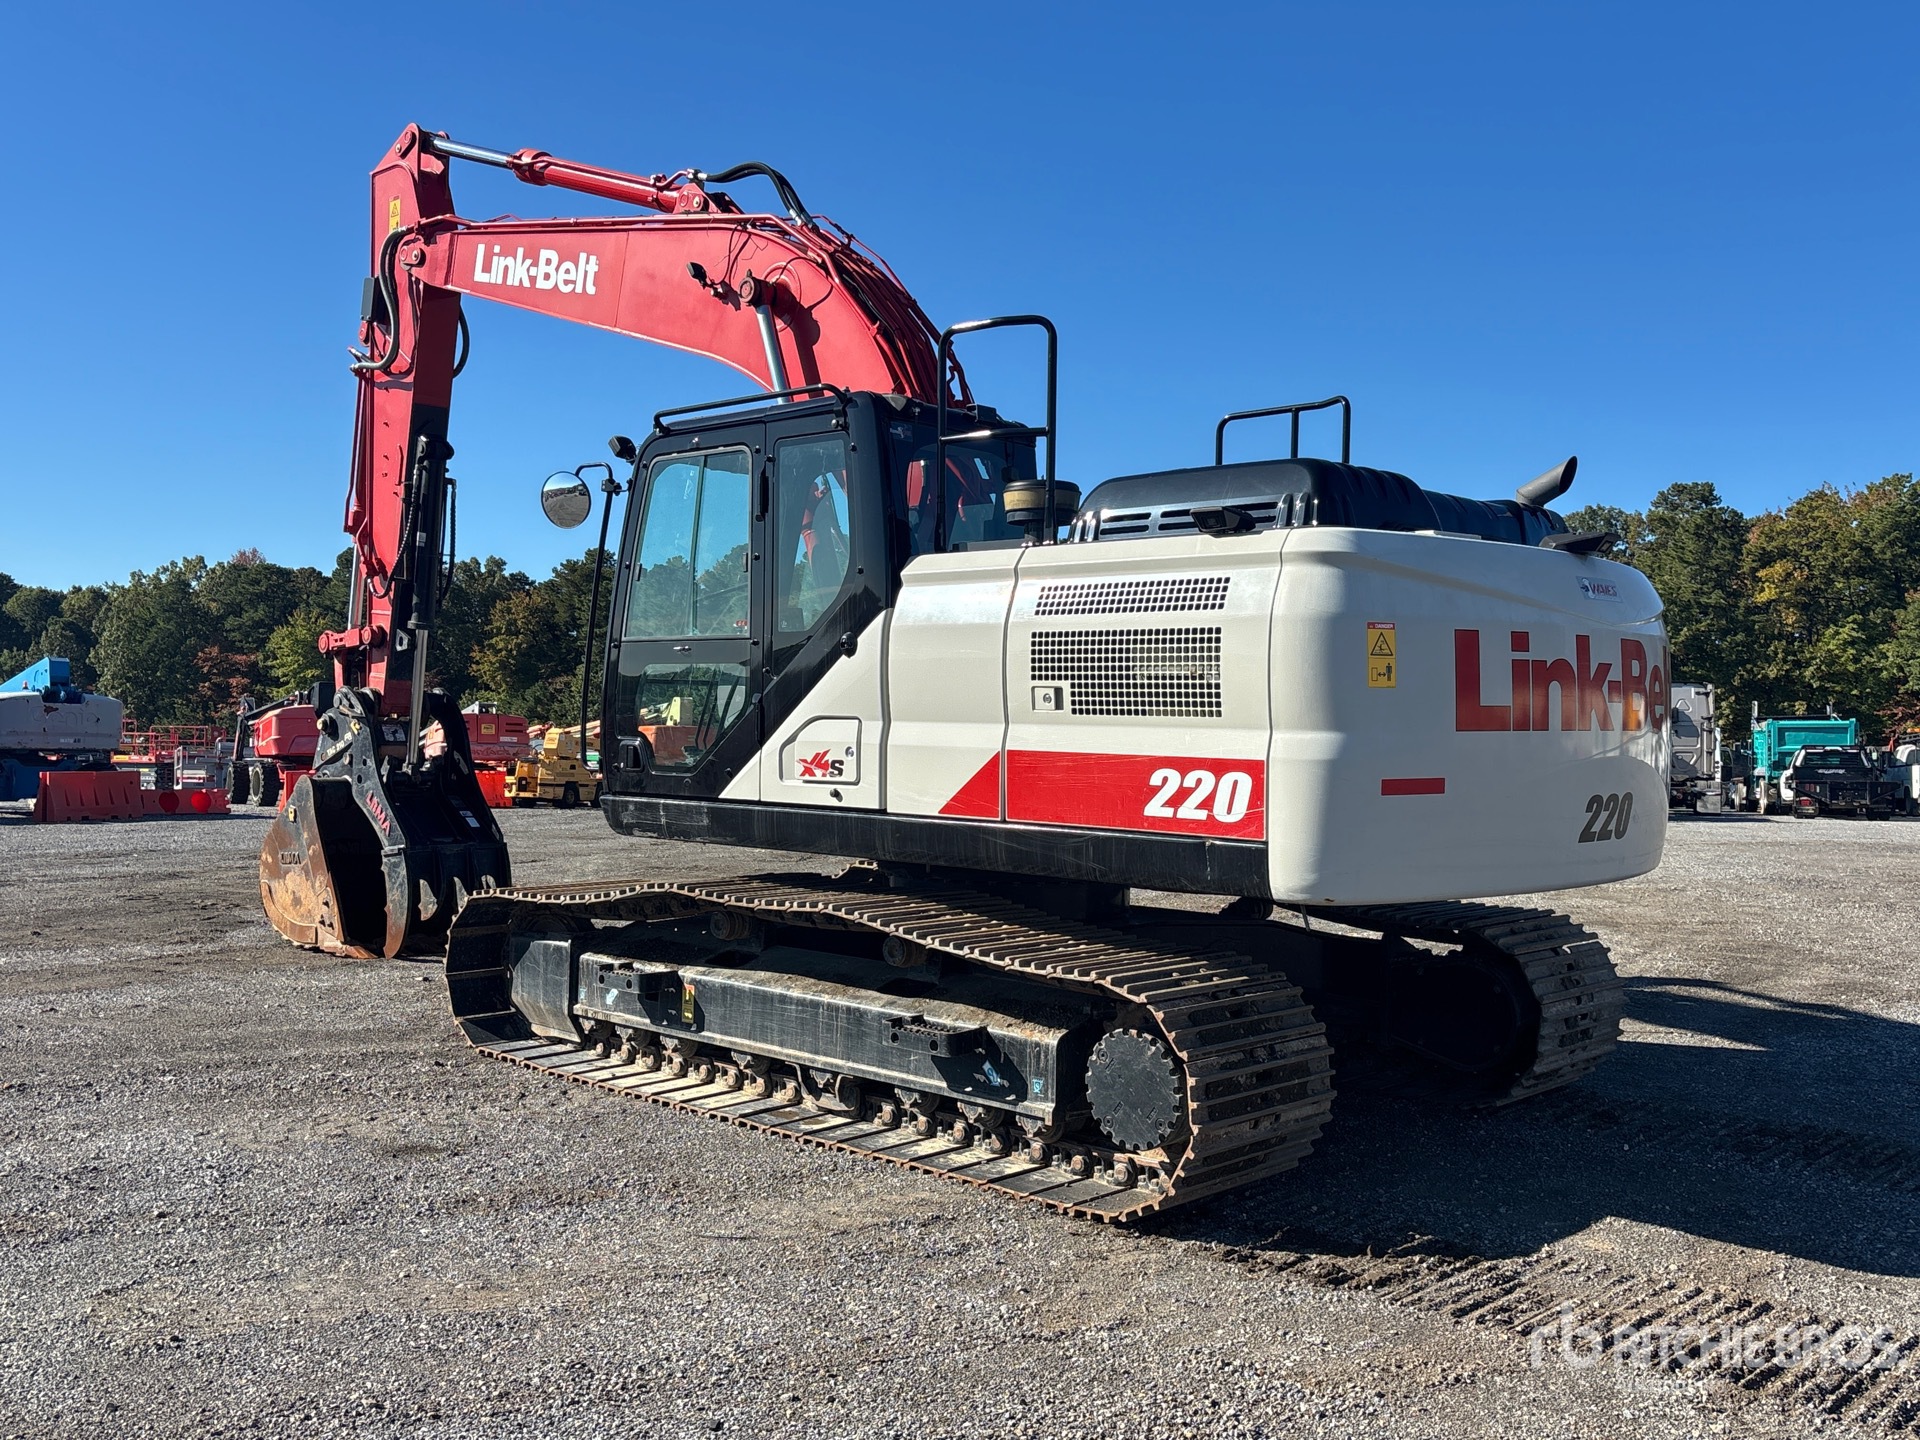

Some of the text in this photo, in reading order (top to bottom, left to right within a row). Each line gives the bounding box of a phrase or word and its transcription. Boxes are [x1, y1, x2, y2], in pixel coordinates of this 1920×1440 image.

[473, 243, 599, 295] Link-Belt
[1454, 629, 1670, 734] Link-Bel
[1143, 767, 1253, 823] 220
[1578, 791, 1634, 844] 220
